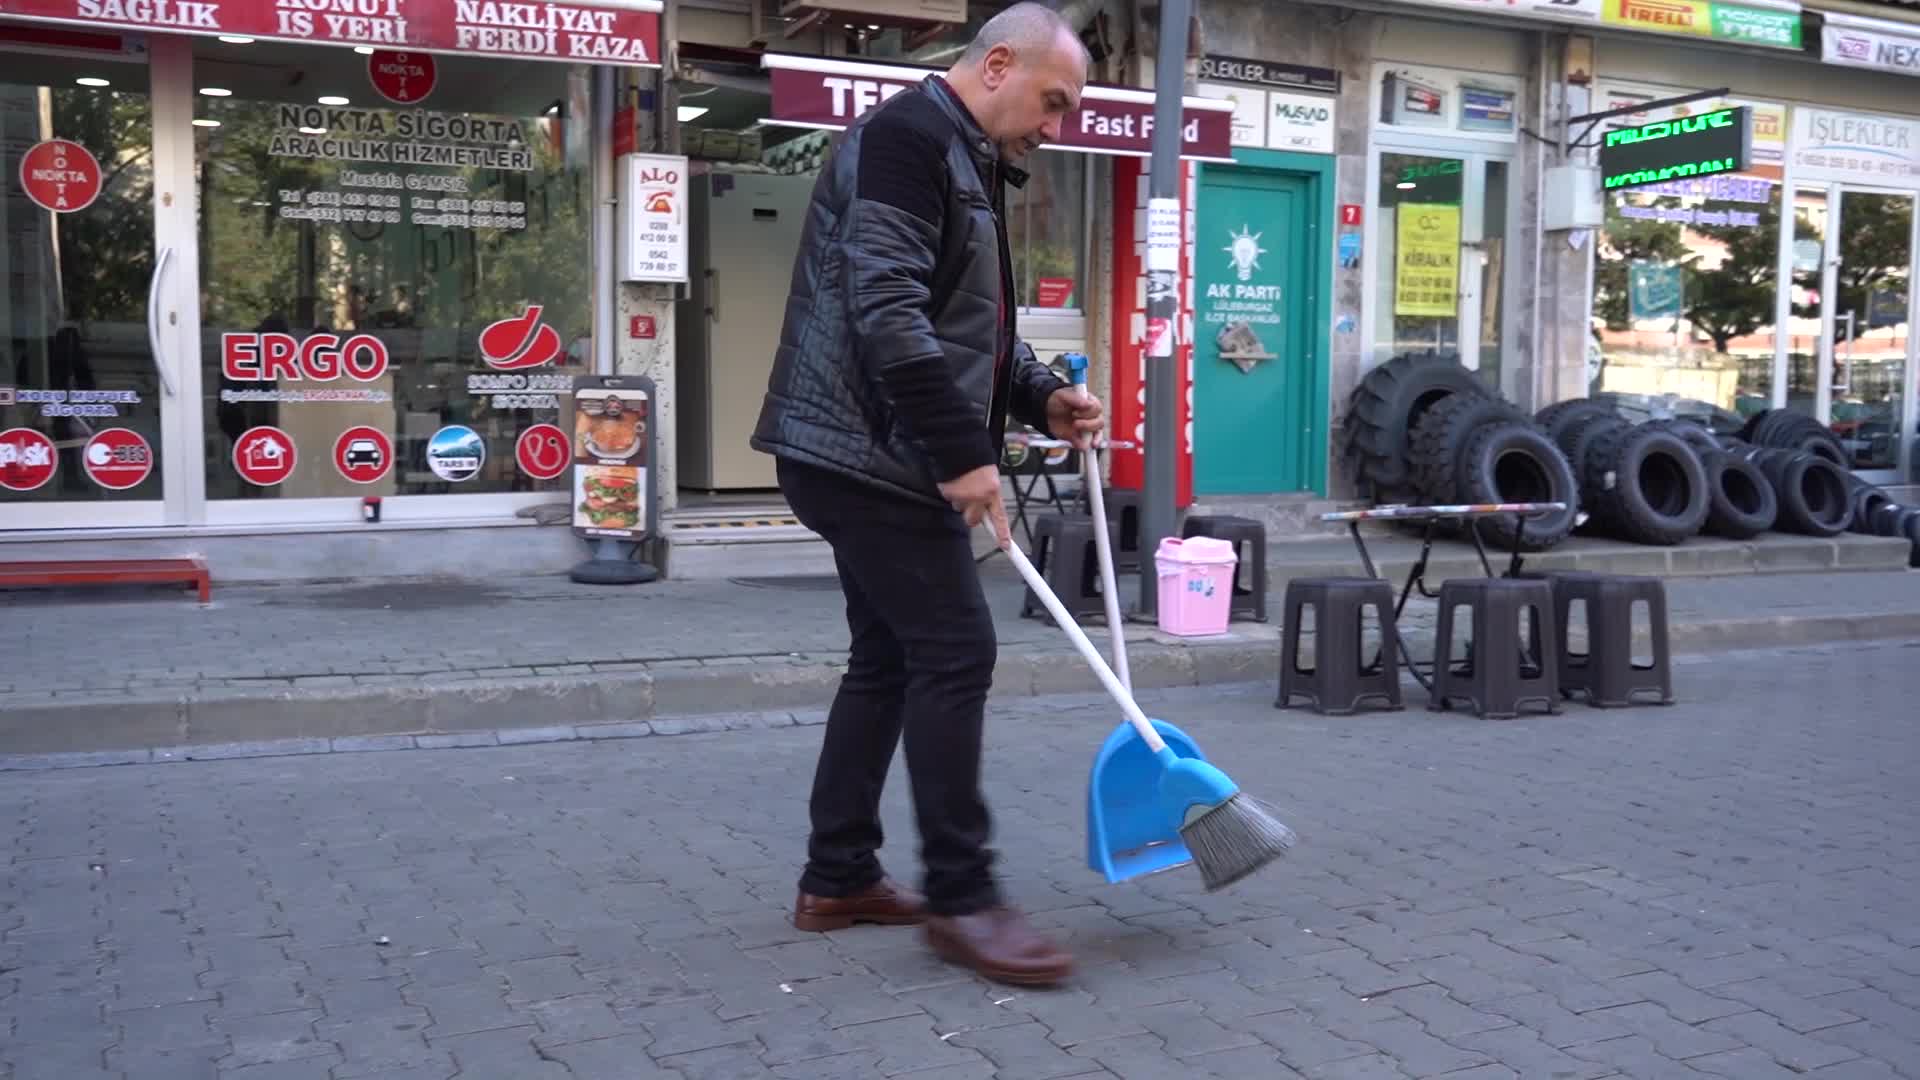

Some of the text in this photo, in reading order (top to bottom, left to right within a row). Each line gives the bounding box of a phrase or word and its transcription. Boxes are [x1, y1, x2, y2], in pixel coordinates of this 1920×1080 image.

[323, 13, 408, 43] YERİ
[456, 1, 616, 34] NAKLİYAT
[456, 25, 648, 61] FERDİ KAZA
[281, 106, 522, 142] NOKTA SİGORTA
[1081, 110, 1135, 138] Fast
[1141, 114, 1199, 143] Fd
[270, 136, 532, 168] ARACILIK HİZMETLERİ
[31, 168, 88, 183] NOKTA
[640, 167, 678, 185] ALO
[1207, 283, 1231, 298] AK
[222, 333, 389, 381] ERGO
